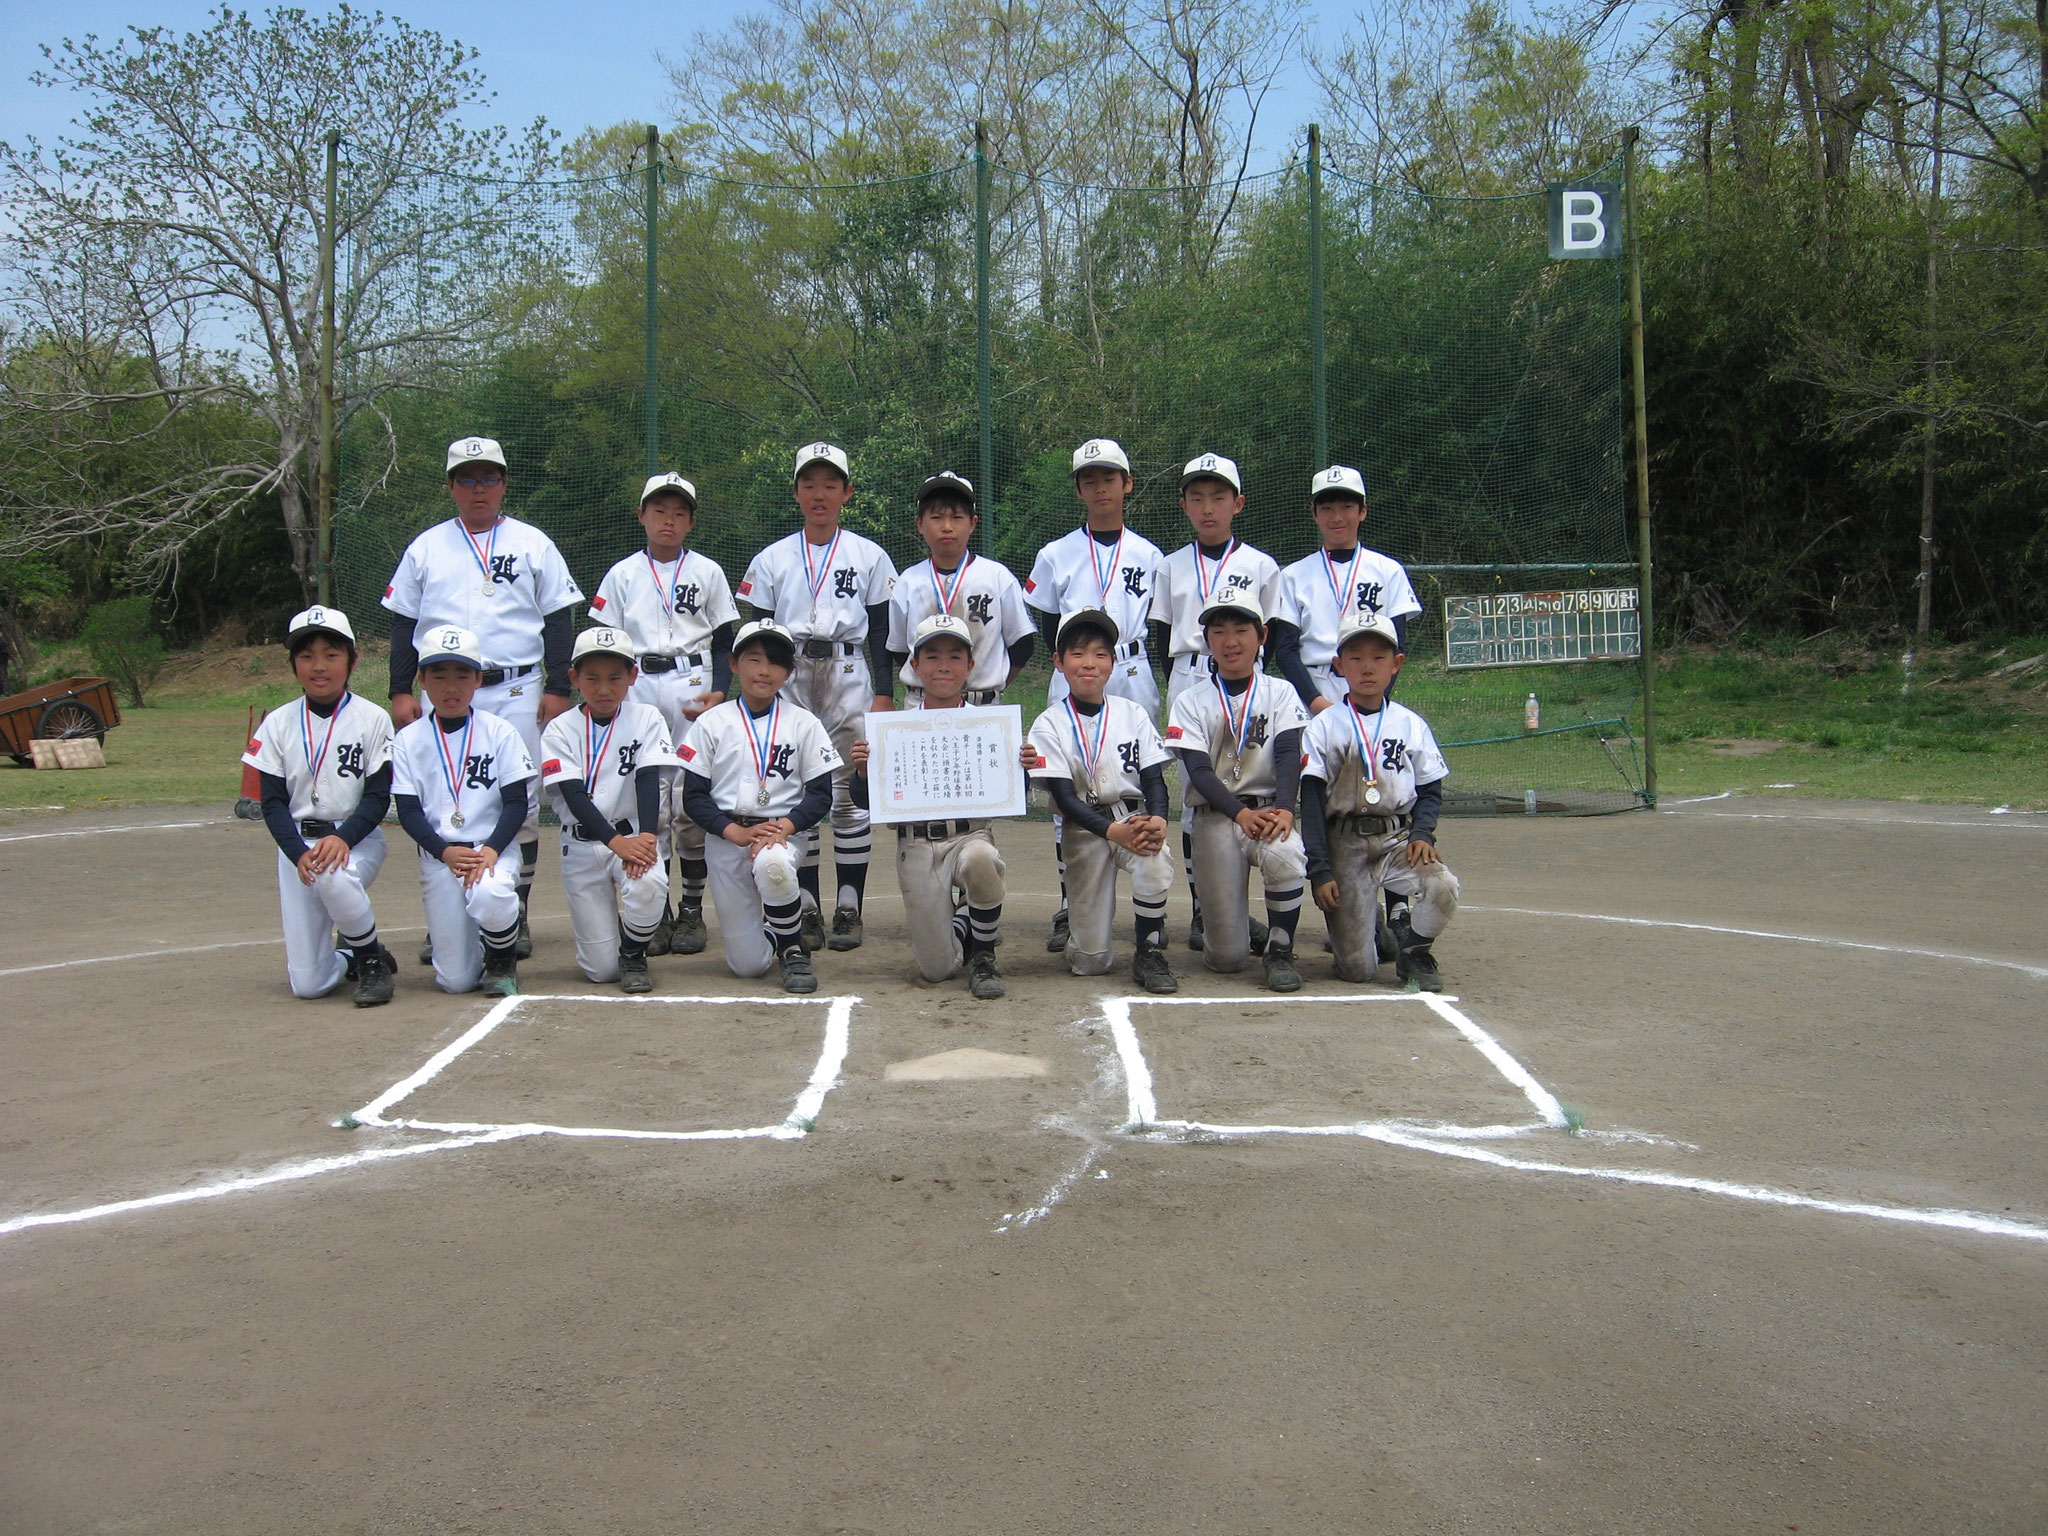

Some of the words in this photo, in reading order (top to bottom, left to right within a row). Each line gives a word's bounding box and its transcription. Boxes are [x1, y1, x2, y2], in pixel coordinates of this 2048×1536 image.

[1562, 190, 1605, 250] B
[1484, 599, 1490, 615] 1
[1497, 598, 1506, 615] 2
[1511, 597, 1520, 613] 3
[1567, 595, 1576, 611] 7
[1579, 594, 1589, 611] 8
[1593, 593, 1602, 609] 9
[1606, 593, 1618, 610] 10
[1620, 591, 1636, 609] 計
[1512, 620, 1522, 637] 5
[920, 737, 929, 797] これを表彰します
[988, 743, 999, 768] 賞状
